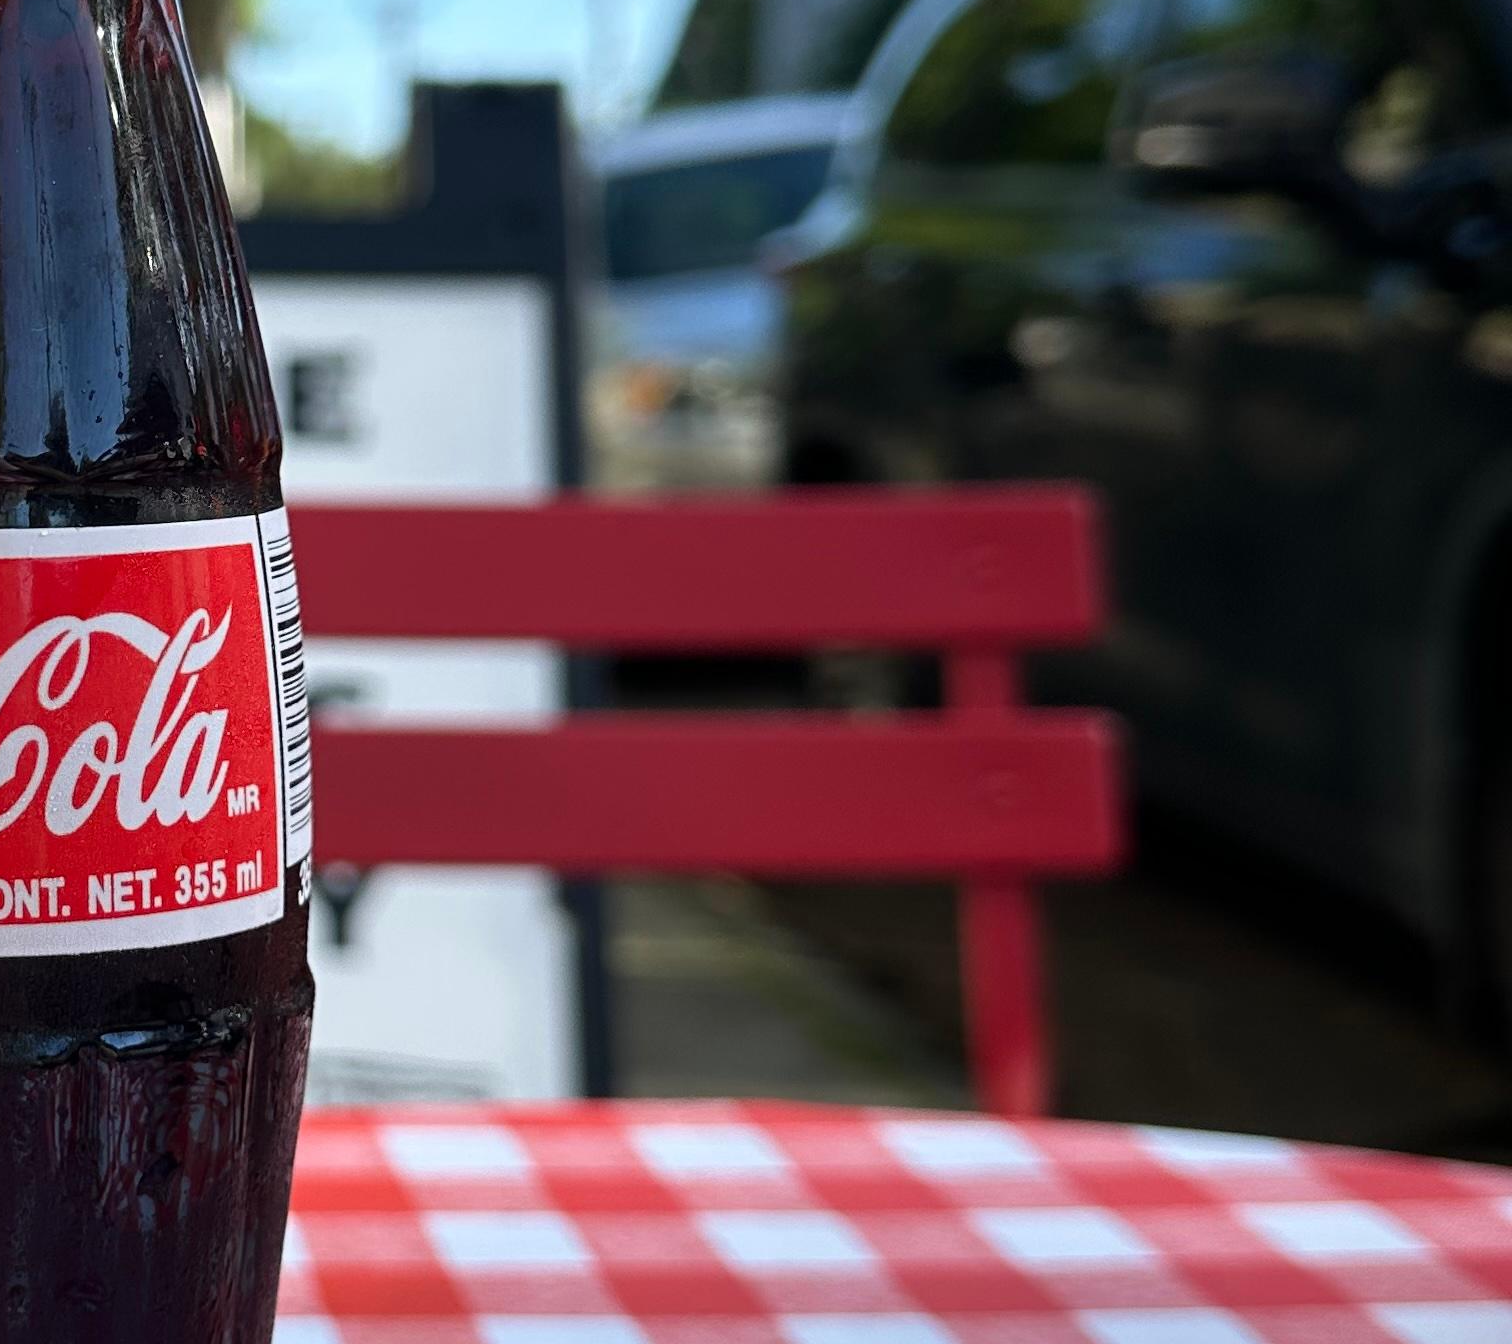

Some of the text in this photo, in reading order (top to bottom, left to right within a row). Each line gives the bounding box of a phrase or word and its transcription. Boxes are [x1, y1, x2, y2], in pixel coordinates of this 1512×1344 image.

[227, 784, 261, 818] MR
[88, 867, 163, 915] NET.
[174, 858, 227, 906] 355
[236, 849, 263, 893] ml
